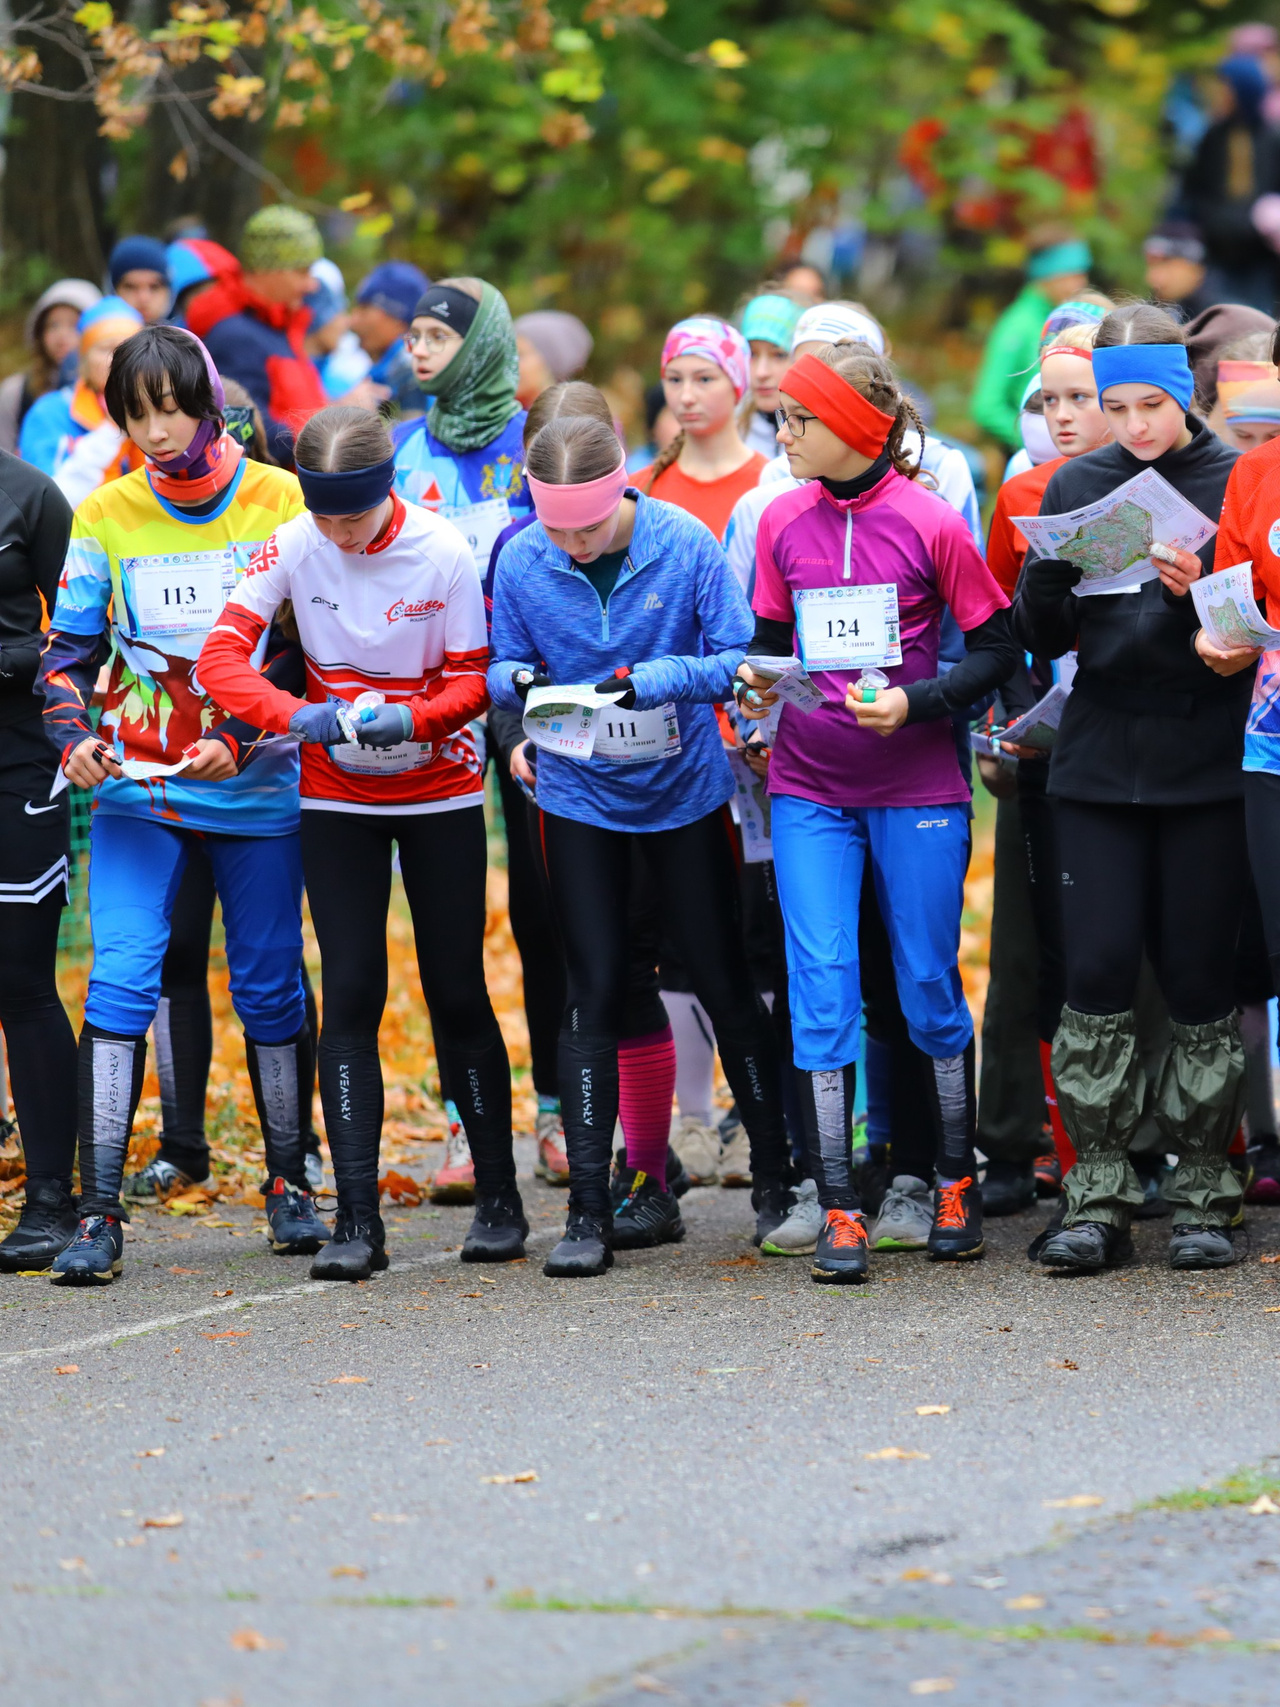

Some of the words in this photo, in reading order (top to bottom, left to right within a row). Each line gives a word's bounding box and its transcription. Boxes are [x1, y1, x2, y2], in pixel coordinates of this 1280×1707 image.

[792, 558, 834, 566] noname
[162, 586, 196, 606] 113
[826, 618, 860, 638] 124
[606, 722, 637, 738] 111
[558, 738, 584, 749] 111.2
[630, 739, 656, 747] линия
[622, 755, 659, 764] СОРЕВНОВАНИЯ
